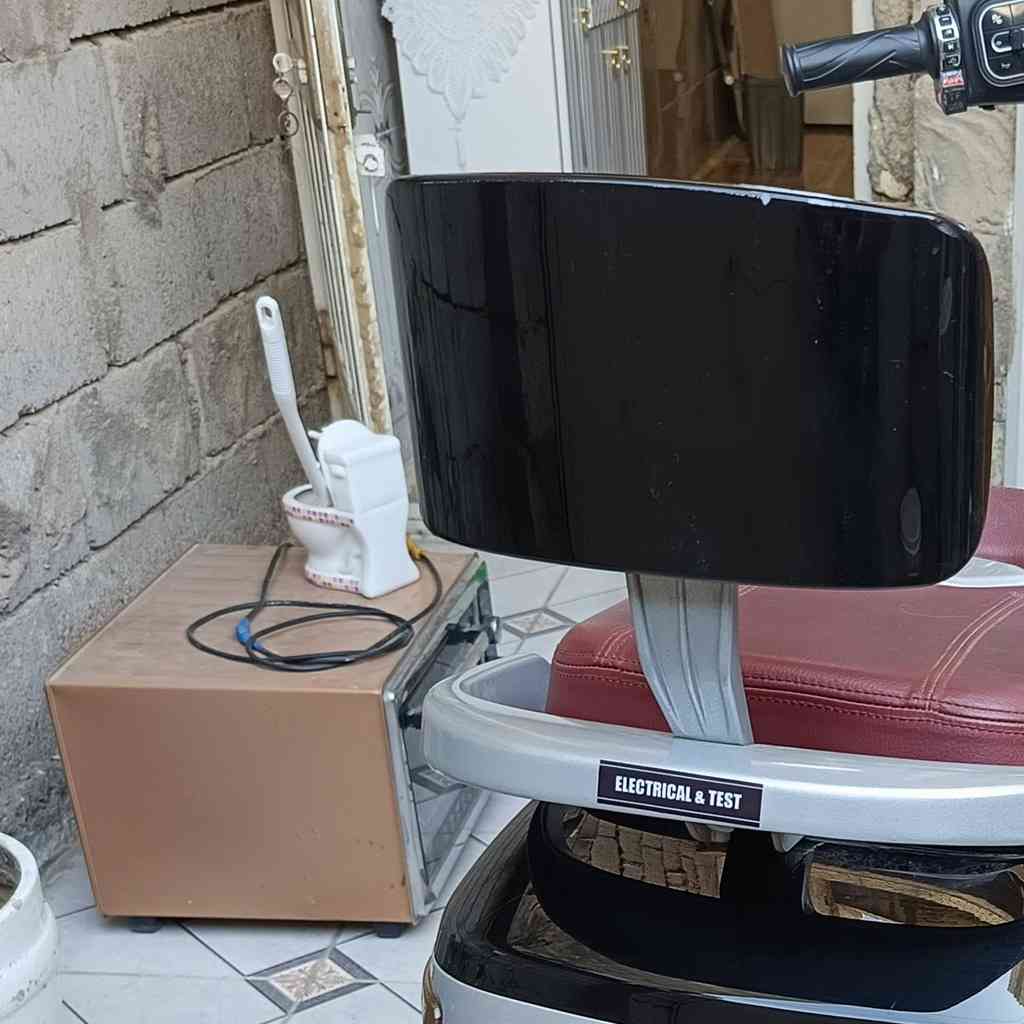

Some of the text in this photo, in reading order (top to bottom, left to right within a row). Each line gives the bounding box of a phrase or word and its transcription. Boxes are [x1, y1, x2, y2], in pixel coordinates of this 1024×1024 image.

[615, 776, 743, 810] ELECTRICAL & TEST
